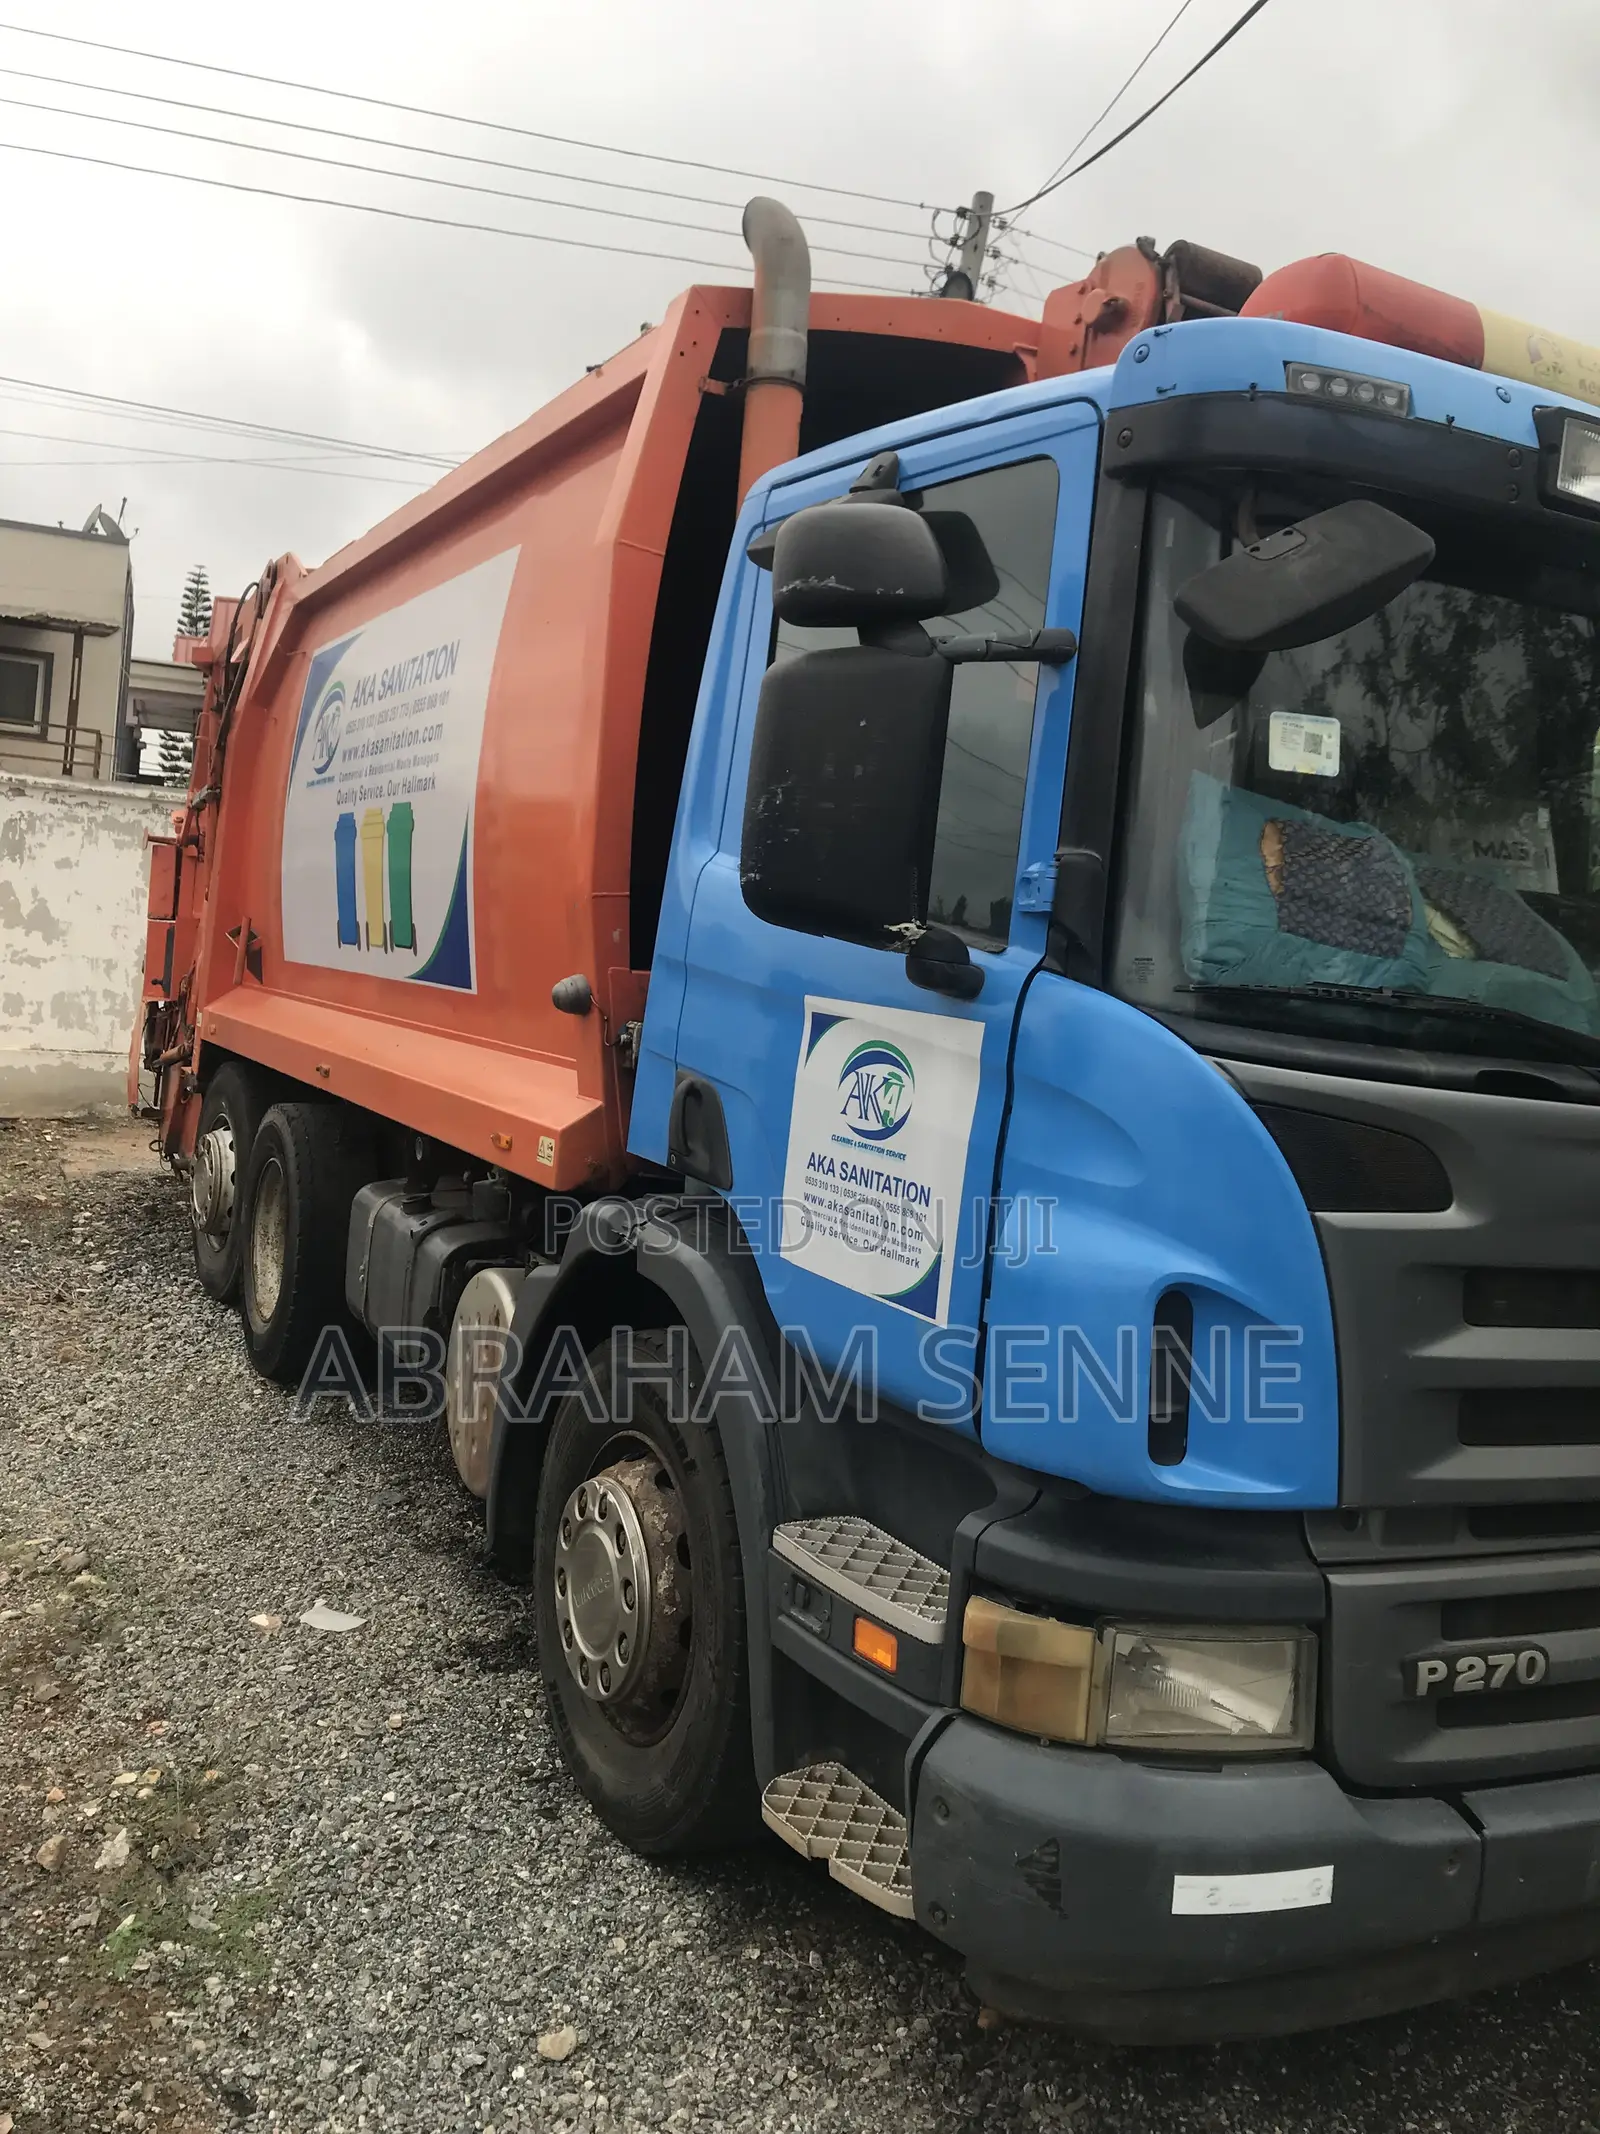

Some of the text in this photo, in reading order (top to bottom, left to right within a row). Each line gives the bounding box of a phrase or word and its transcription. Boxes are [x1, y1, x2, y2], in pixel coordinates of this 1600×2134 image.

[351, 638, 461, 711] AKA SANITATION
[341, 722, 444, 763] www.akasanitation.com
[336, 788, 358, 806] Quality
[387, 780, 400, 796] Our
[402, 772, 436, 795] Hallmark
[832, 1134, 854, 1146] CLEANING
[857, 1142, 886, 1154] SANITATION
[886, 1149, 907, 1161] SERVICE
[804, 1175, 818, 1188] 0535
[818, 1180, 828, 1190] 310
[830, 1183, 840, 1194] 133
[886, 1202, 901, 1214] 0555
[916, 1212, 928, 1223] 101
[806, 1152, 932, 1208] AKA SANITATION
[804, 1192, 924, 1242] www.akasanitation.com
[800, 1216, 828, 1236] Quality
[862, 1239, 879, 1252] Our
[880, 1246, 921, 1269] Hallmark
[891, 1237, 922, 1254] Managers
[1416, 1650, 1547, 1696] P 270
